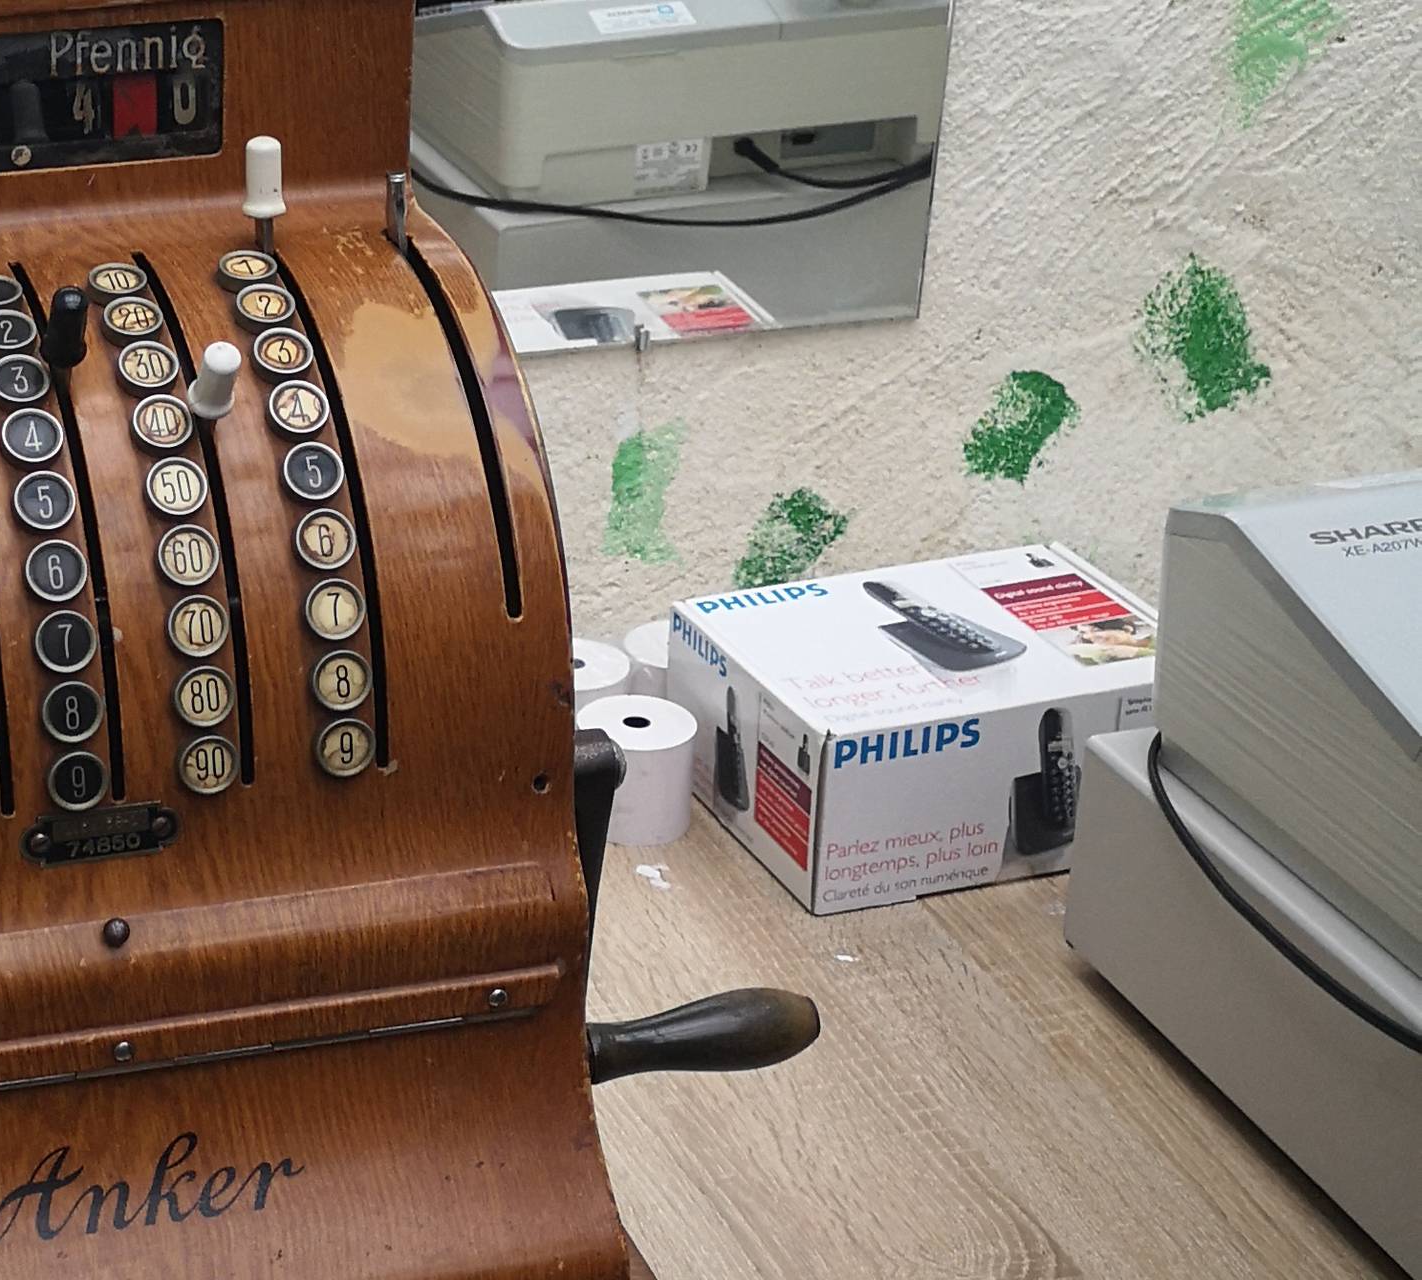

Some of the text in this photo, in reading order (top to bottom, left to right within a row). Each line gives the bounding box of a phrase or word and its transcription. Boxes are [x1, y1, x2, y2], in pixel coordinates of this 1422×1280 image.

[172, 79, 197, 126] 0
[103, 270, 130, 291] 10
[239, 260, 254, 276] 1
[119, 306, 150, 330] 20
[259, 295, 277, 317] 2
[0, 320, 18, 344] 2
[135, 351, 165, 380] 30
[277, 339, 293, 364] 3
[11, 366, 29, 394] 3
[146, 407, 180, 437] 40
[289, 392, 309, 423] 4
[24, 419, 42, 452] 4
[161, 469, 192, 505] 50
[305, 455, 323, 488] 5
[37, 485, 53, 519] 5
[172, 538, 203, 575] 60
[318, 523, 334, 557] 6
[47, 554, 64, 589] 6
[326, 592, 340, 626] 7
[696, 582, 830, 614] PHILIPS
[58, 623, 73, 660] 7
[183, 609, 214, 646] 70
[673, 611, 727, 677] PHILIPS
[336, 665, 350, 698] 8
[787, 664, 920, 690] Talk better
[190, 678, 220, 714] 80
[66, 696, 80, 730] 8
[340, 732, 354, 764] 9
[834, 718, 981, 769] PHILIPS
[196, 746, 225, 781] 90
[72, 766, 86, 798] 9
[826, 821, 985, 860] Parlez mieux, plus
[824, 841, 998, 882] longtemps, plus loin
[822, 865, 989, 903] Clareté du son numérique
